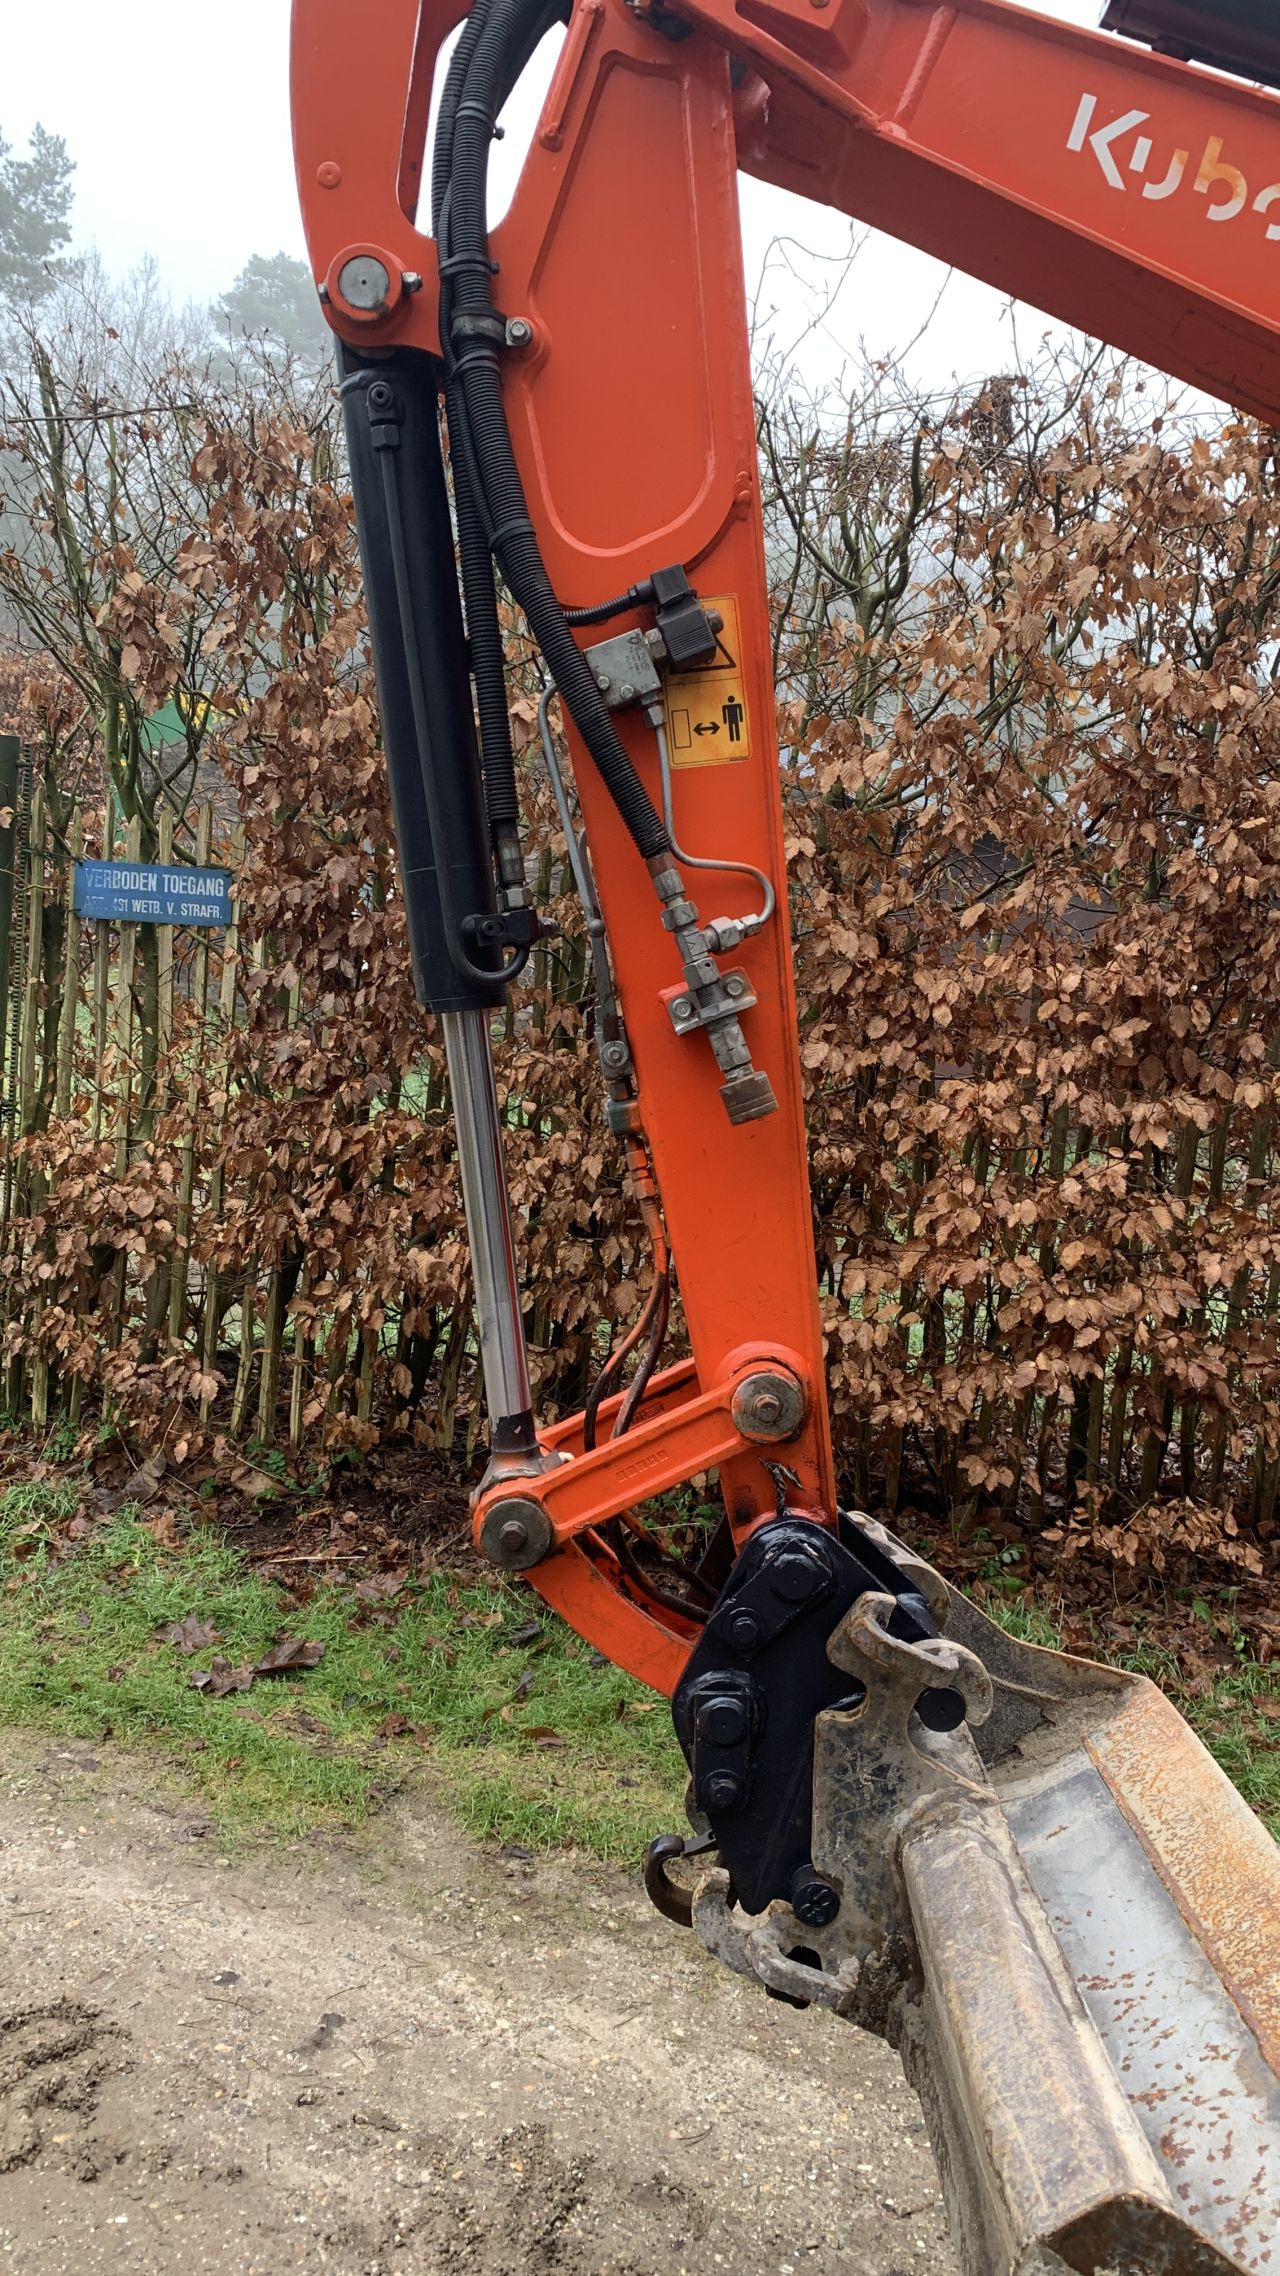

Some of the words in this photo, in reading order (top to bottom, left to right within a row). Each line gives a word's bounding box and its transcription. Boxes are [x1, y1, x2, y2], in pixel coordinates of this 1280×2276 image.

[85, 867, 157, 892] VERBODEN
[162, 874, 224, 897] TOEGANG
[131, 899, 164, 914] WETB.
[166, 901, 177, 915] V.
[180, 902, 223, 919] STRAFR.
